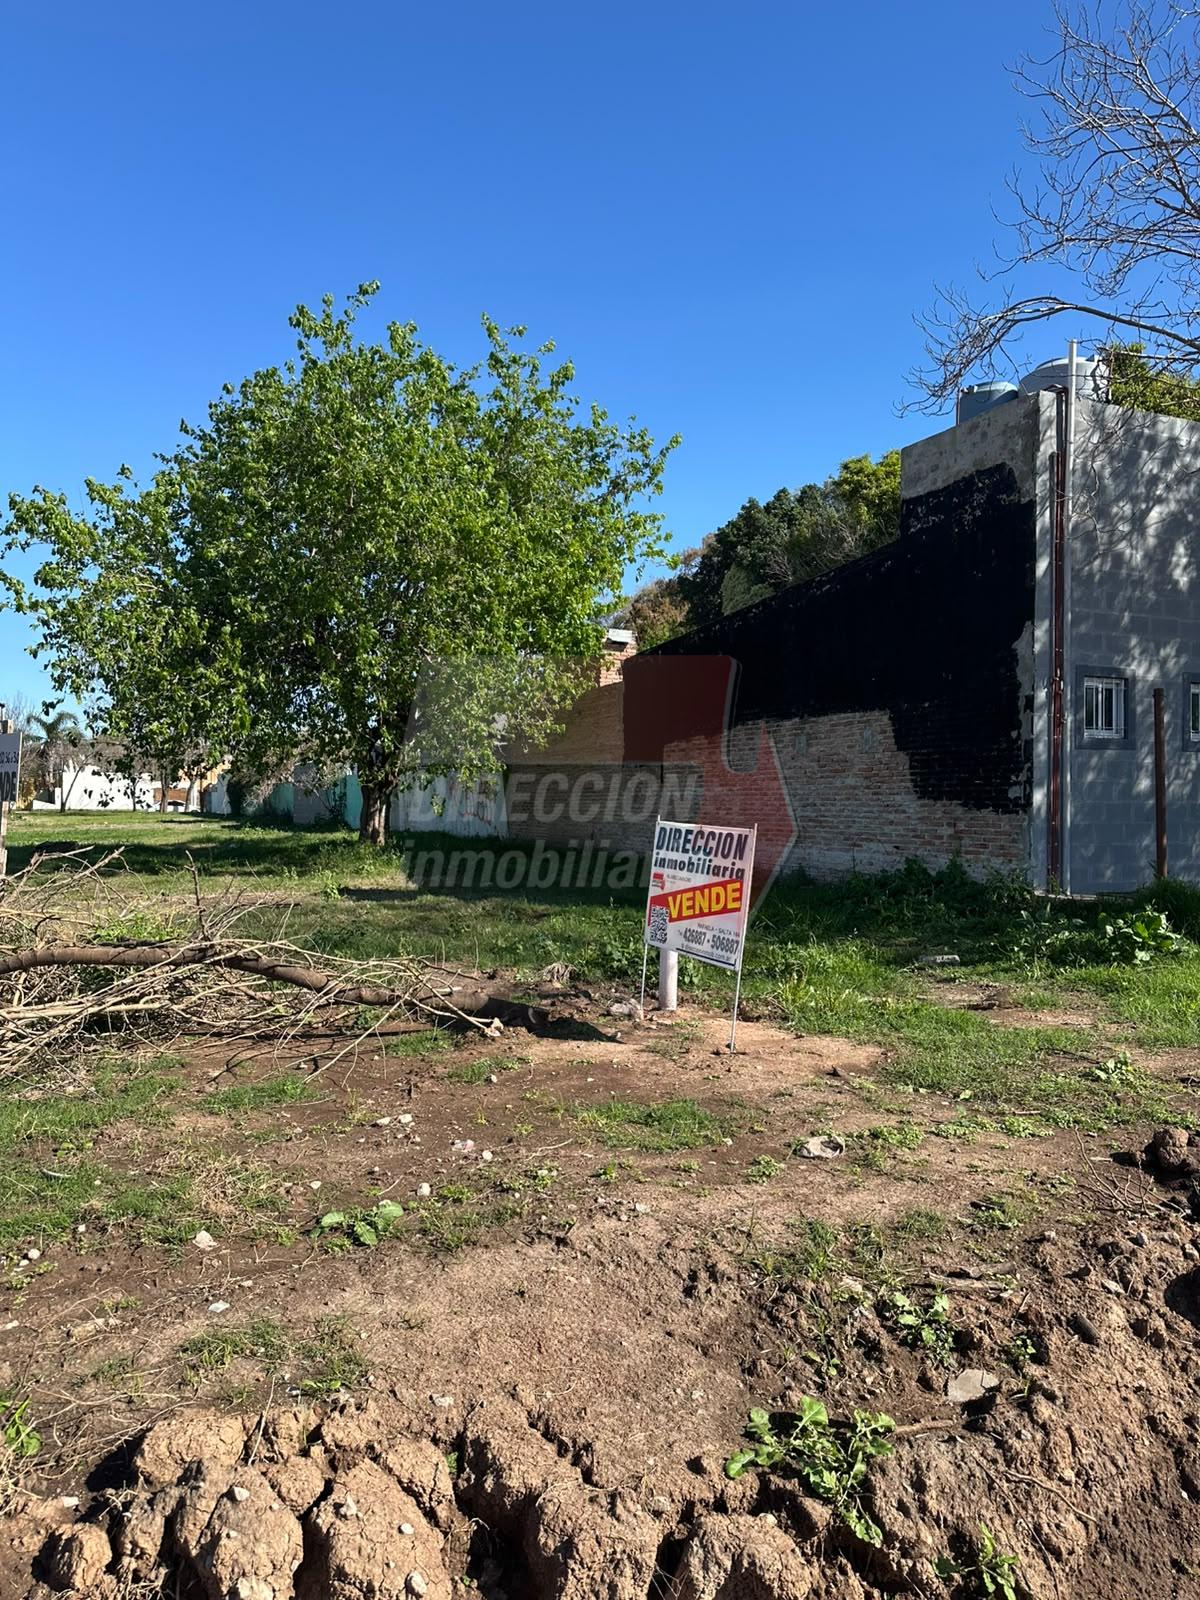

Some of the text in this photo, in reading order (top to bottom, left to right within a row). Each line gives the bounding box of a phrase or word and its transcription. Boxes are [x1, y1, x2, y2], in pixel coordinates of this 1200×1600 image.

[656, 826, 749, 861] DIRECCION
[653, 851, 745, 880] inmobiliaria
[667, 882, 741, 919] VENDE
[710, 934, 739, 955] 506887
